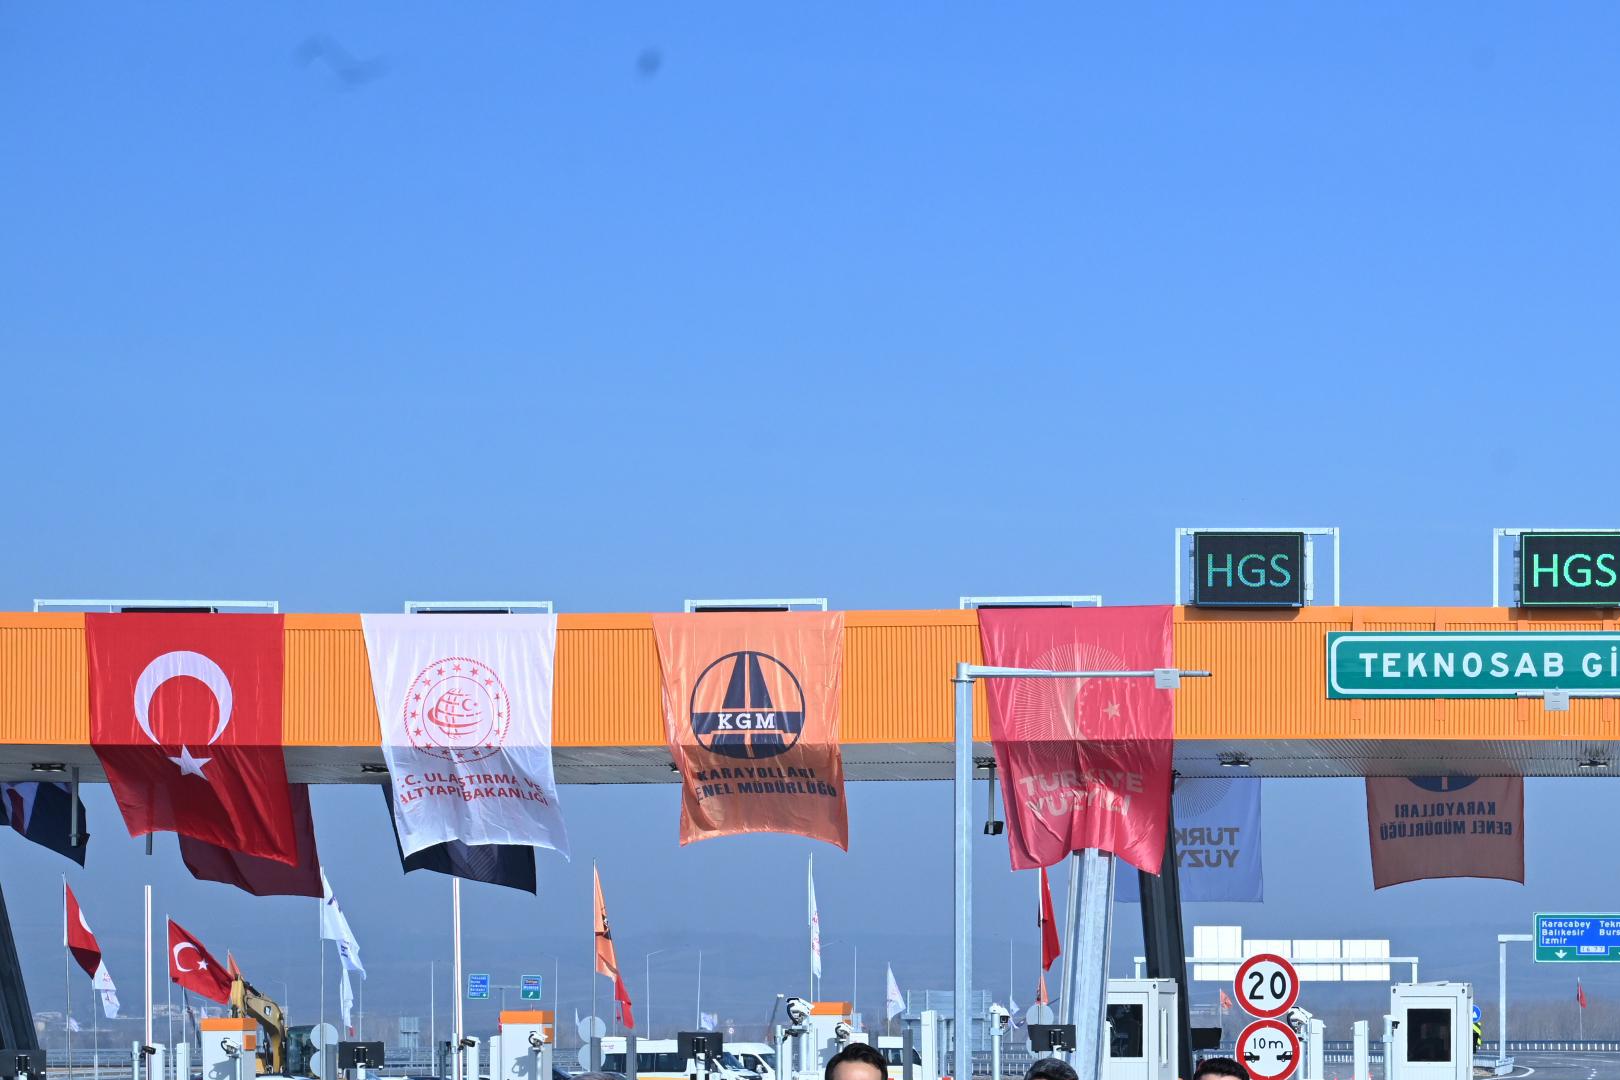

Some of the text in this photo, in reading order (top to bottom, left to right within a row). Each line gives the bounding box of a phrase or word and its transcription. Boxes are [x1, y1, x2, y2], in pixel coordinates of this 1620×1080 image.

[1207, 553, 1291, 588] HGS
[1533, 553, 1617, 588] HGS
[1359, 651, 1565, 678] TEKNOSAB
[717, 713, 775, 730] KGM
[424, 773, 517, 789] ULAŞTIRMA
[696, 766, 816, 782] KARAYOLLARI
[695, 781, 837, 802] ENEL MÜDÜRLÜĞÜ
[1541, 920, 1591, 930] Karacabey
[1541, 928, 1585, 936] Balıkesir
[1248, 971, 1287, 1000] 20
